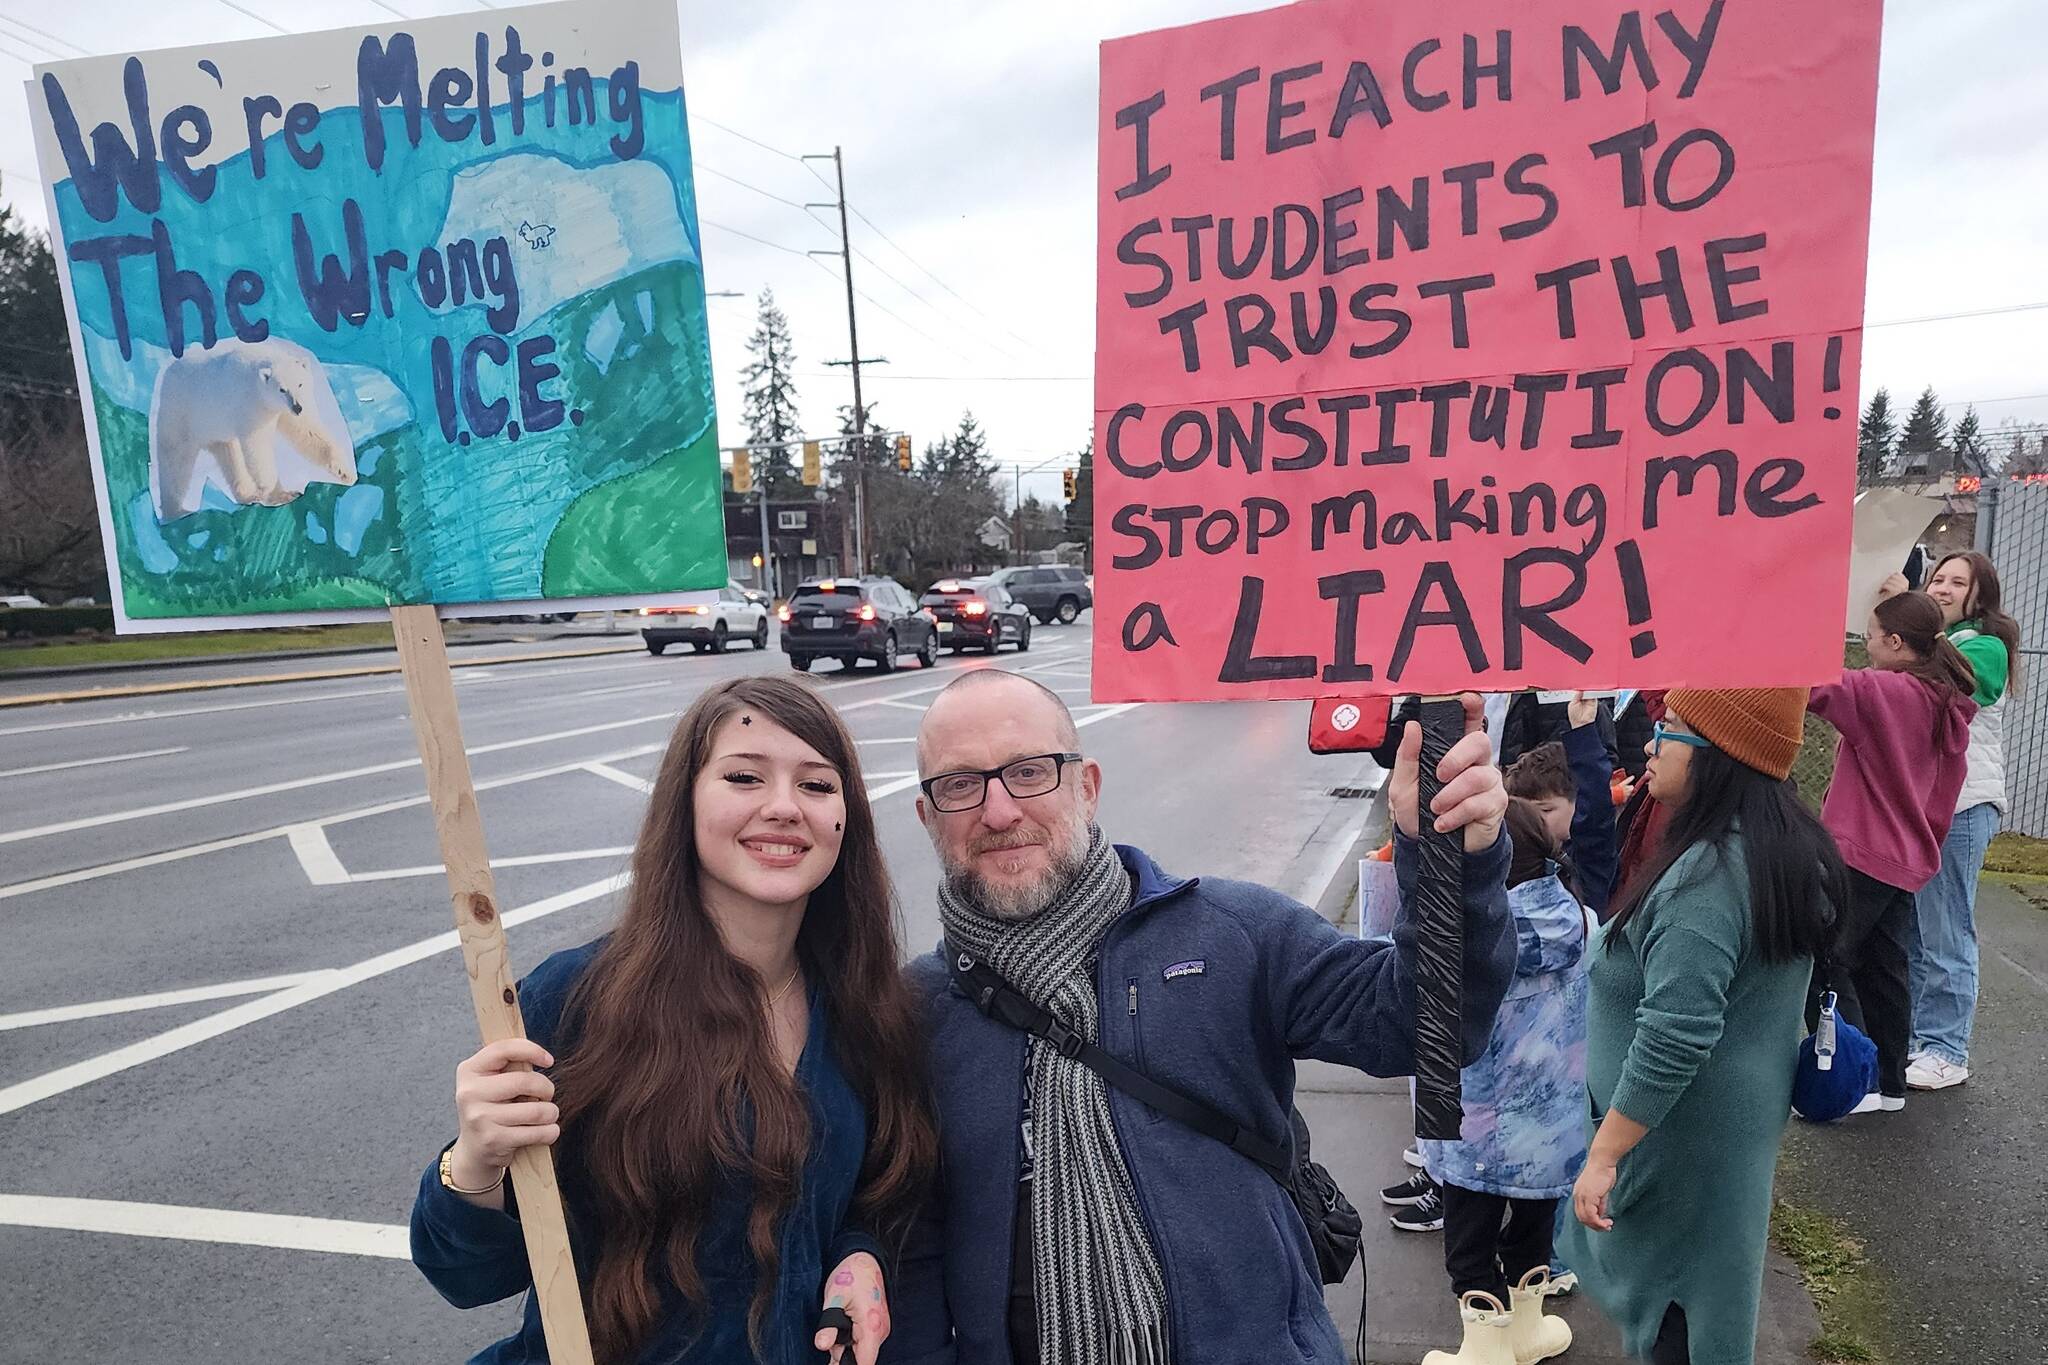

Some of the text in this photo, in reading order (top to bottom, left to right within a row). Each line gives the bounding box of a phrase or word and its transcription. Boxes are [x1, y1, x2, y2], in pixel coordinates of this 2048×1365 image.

[42, 26, 645, 223] We're Melting
[1115, 0, 1726, 201] I TEACH MY
[70, 199, 521, 361] The Wrong
[1117, 120, 1736, 309] STUDENTS TO
[1158, 232, 1769, 373] TRUST THE
[430, 334, 584, 447] I.C.E.
[1111, 450, 1824, 571] STOP making me
[1121, 539, 1658, 684] a LIAR!
[1165, 966, 1204, 980] patagonia
